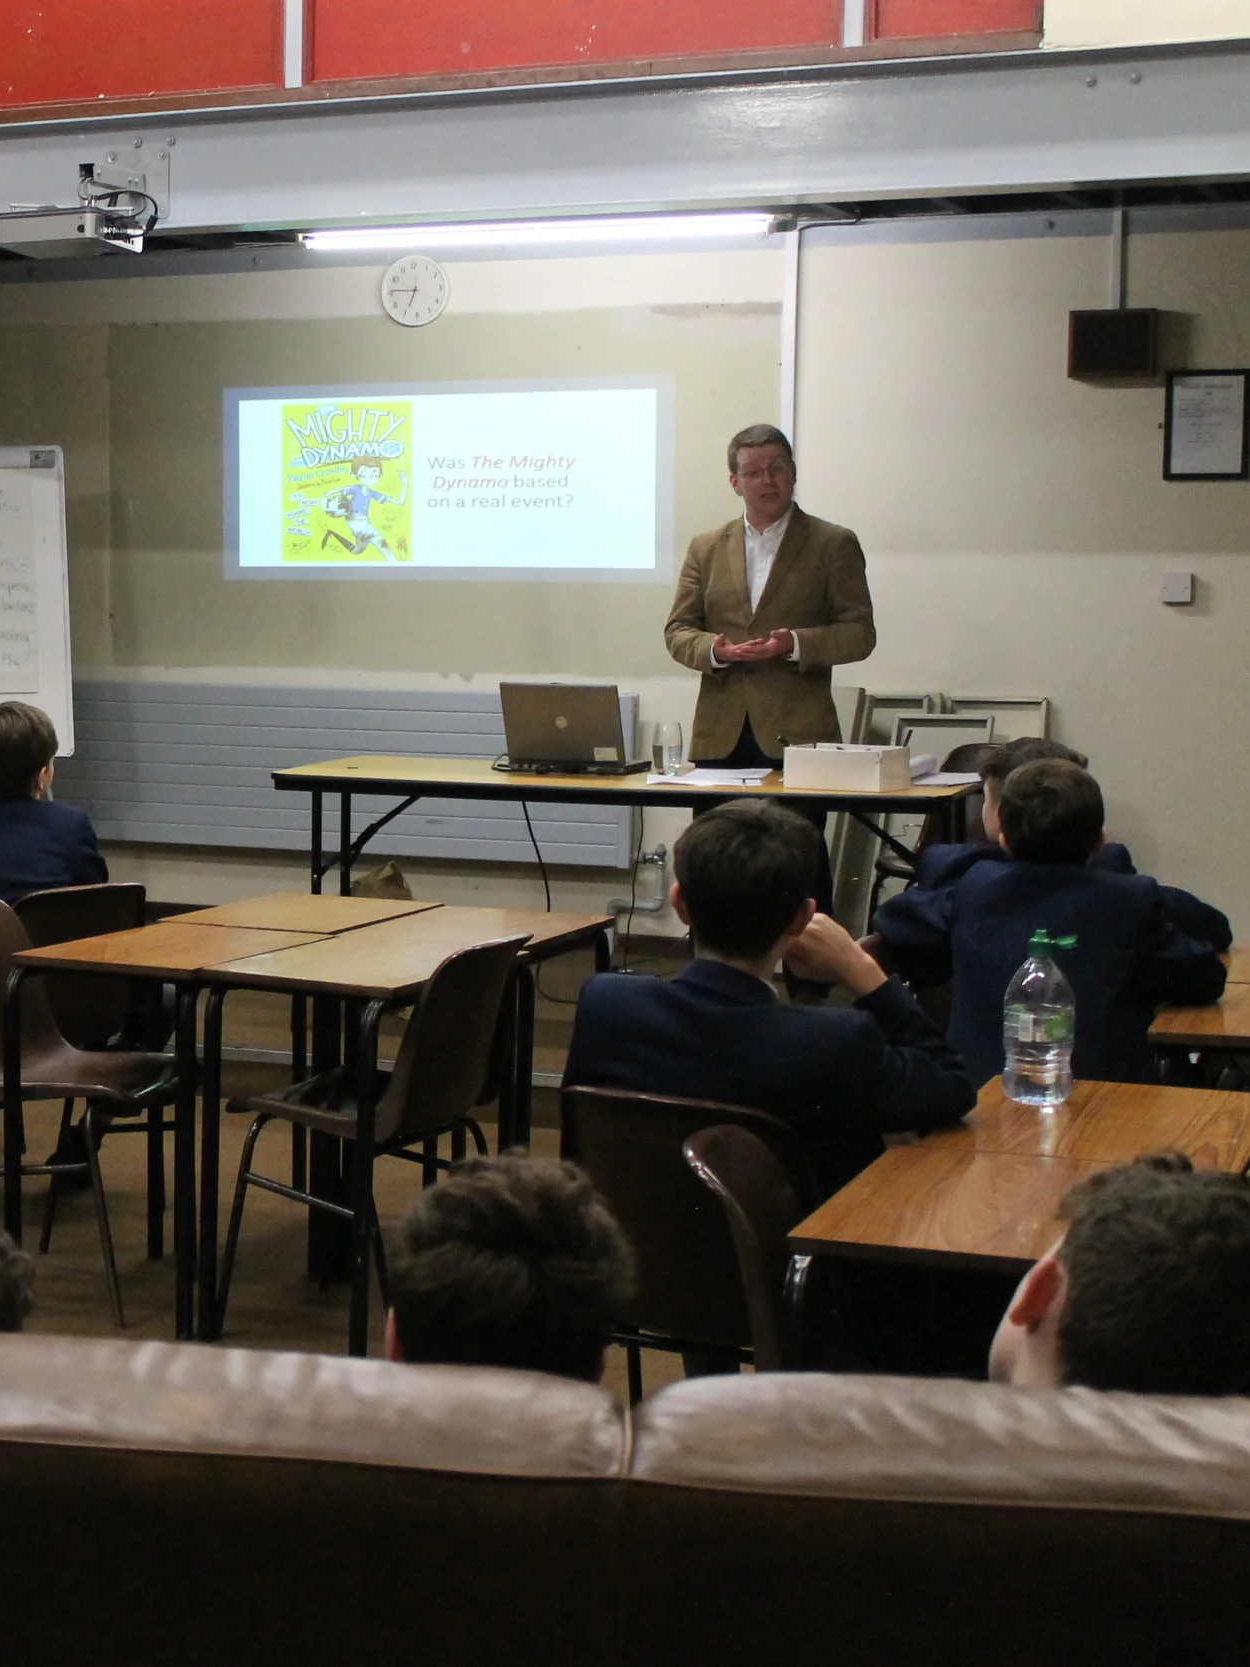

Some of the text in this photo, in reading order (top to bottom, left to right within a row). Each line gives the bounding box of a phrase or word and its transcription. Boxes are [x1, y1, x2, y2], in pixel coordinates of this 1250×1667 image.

[286, 408, 406, 447] MIGHTY
[302, 439, 404, 468] DYNAMO
[427, 454, 577, 471] Was The Mighty
[433, 474, 569, 491] Dynamo based
[427, 494, 574, 508] on a real event?
